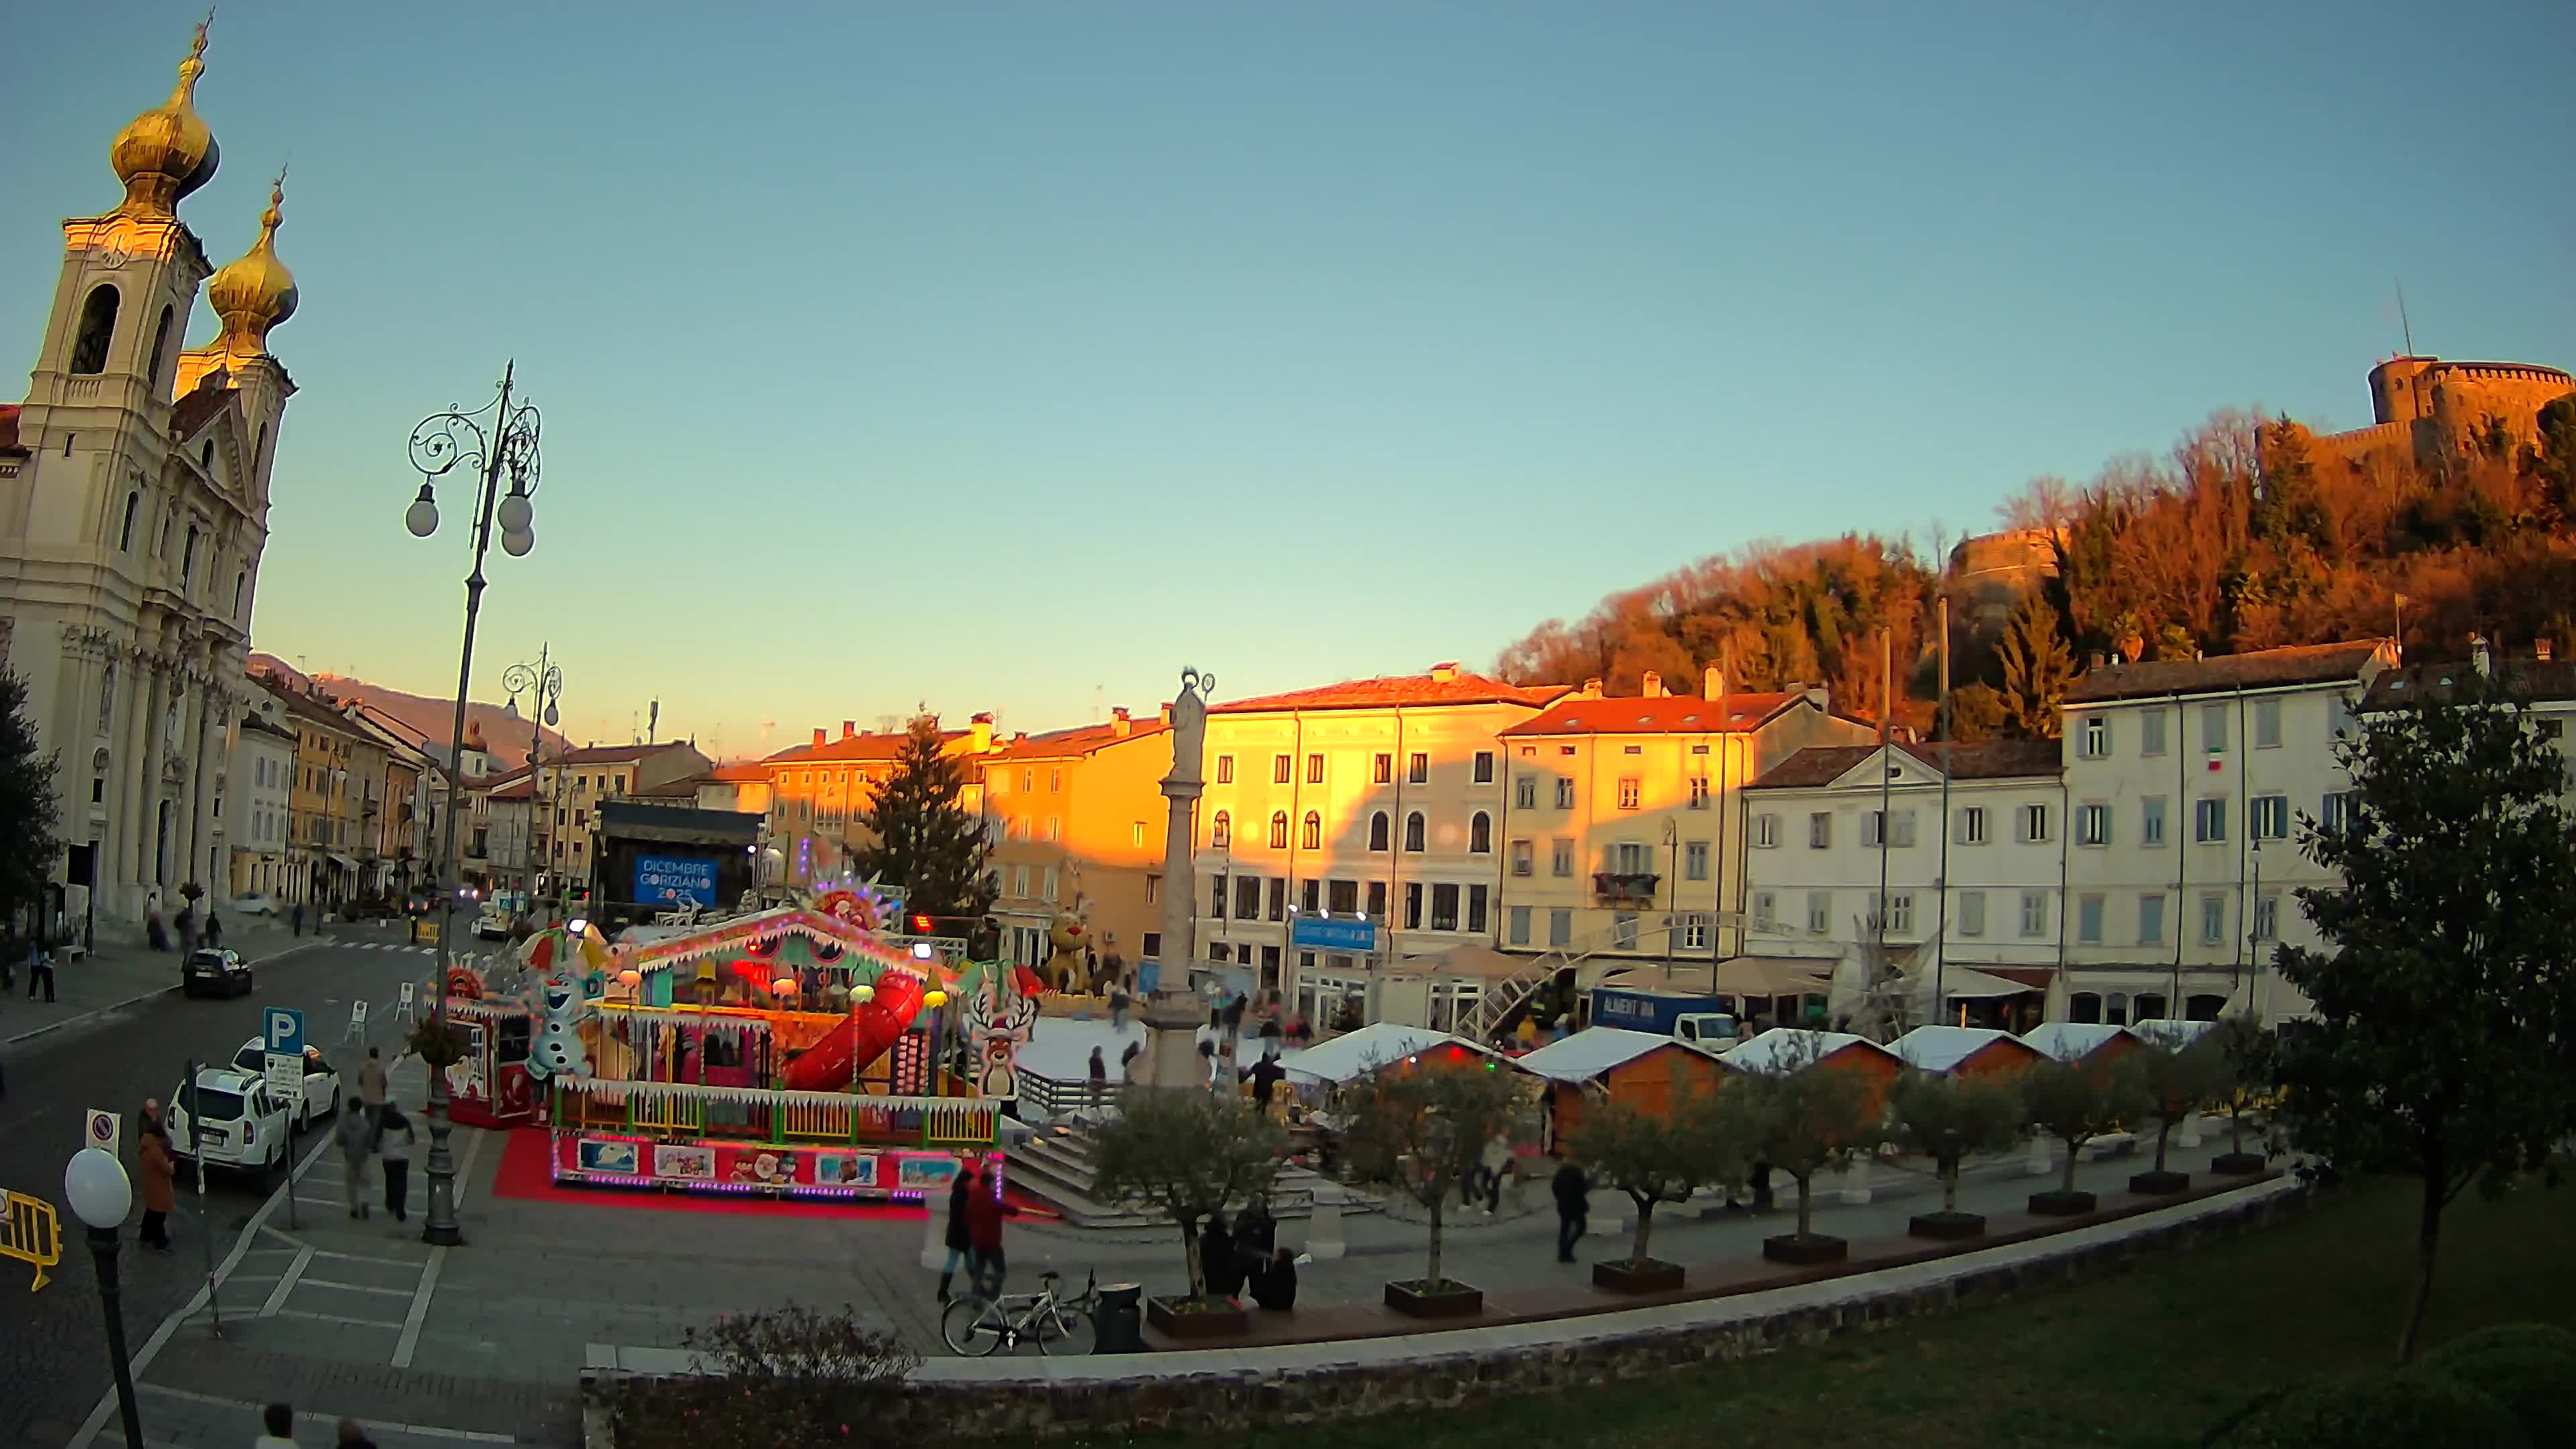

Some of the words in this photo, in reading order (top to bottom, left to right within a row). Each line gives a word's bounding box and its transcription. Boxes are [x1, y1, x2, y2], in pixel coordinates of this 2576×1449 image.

[644, 860, 708, 875] DICEMBRE
[640, 873, 710, 889] GORIZIANO
[272, 1012, 296, 1048] P
